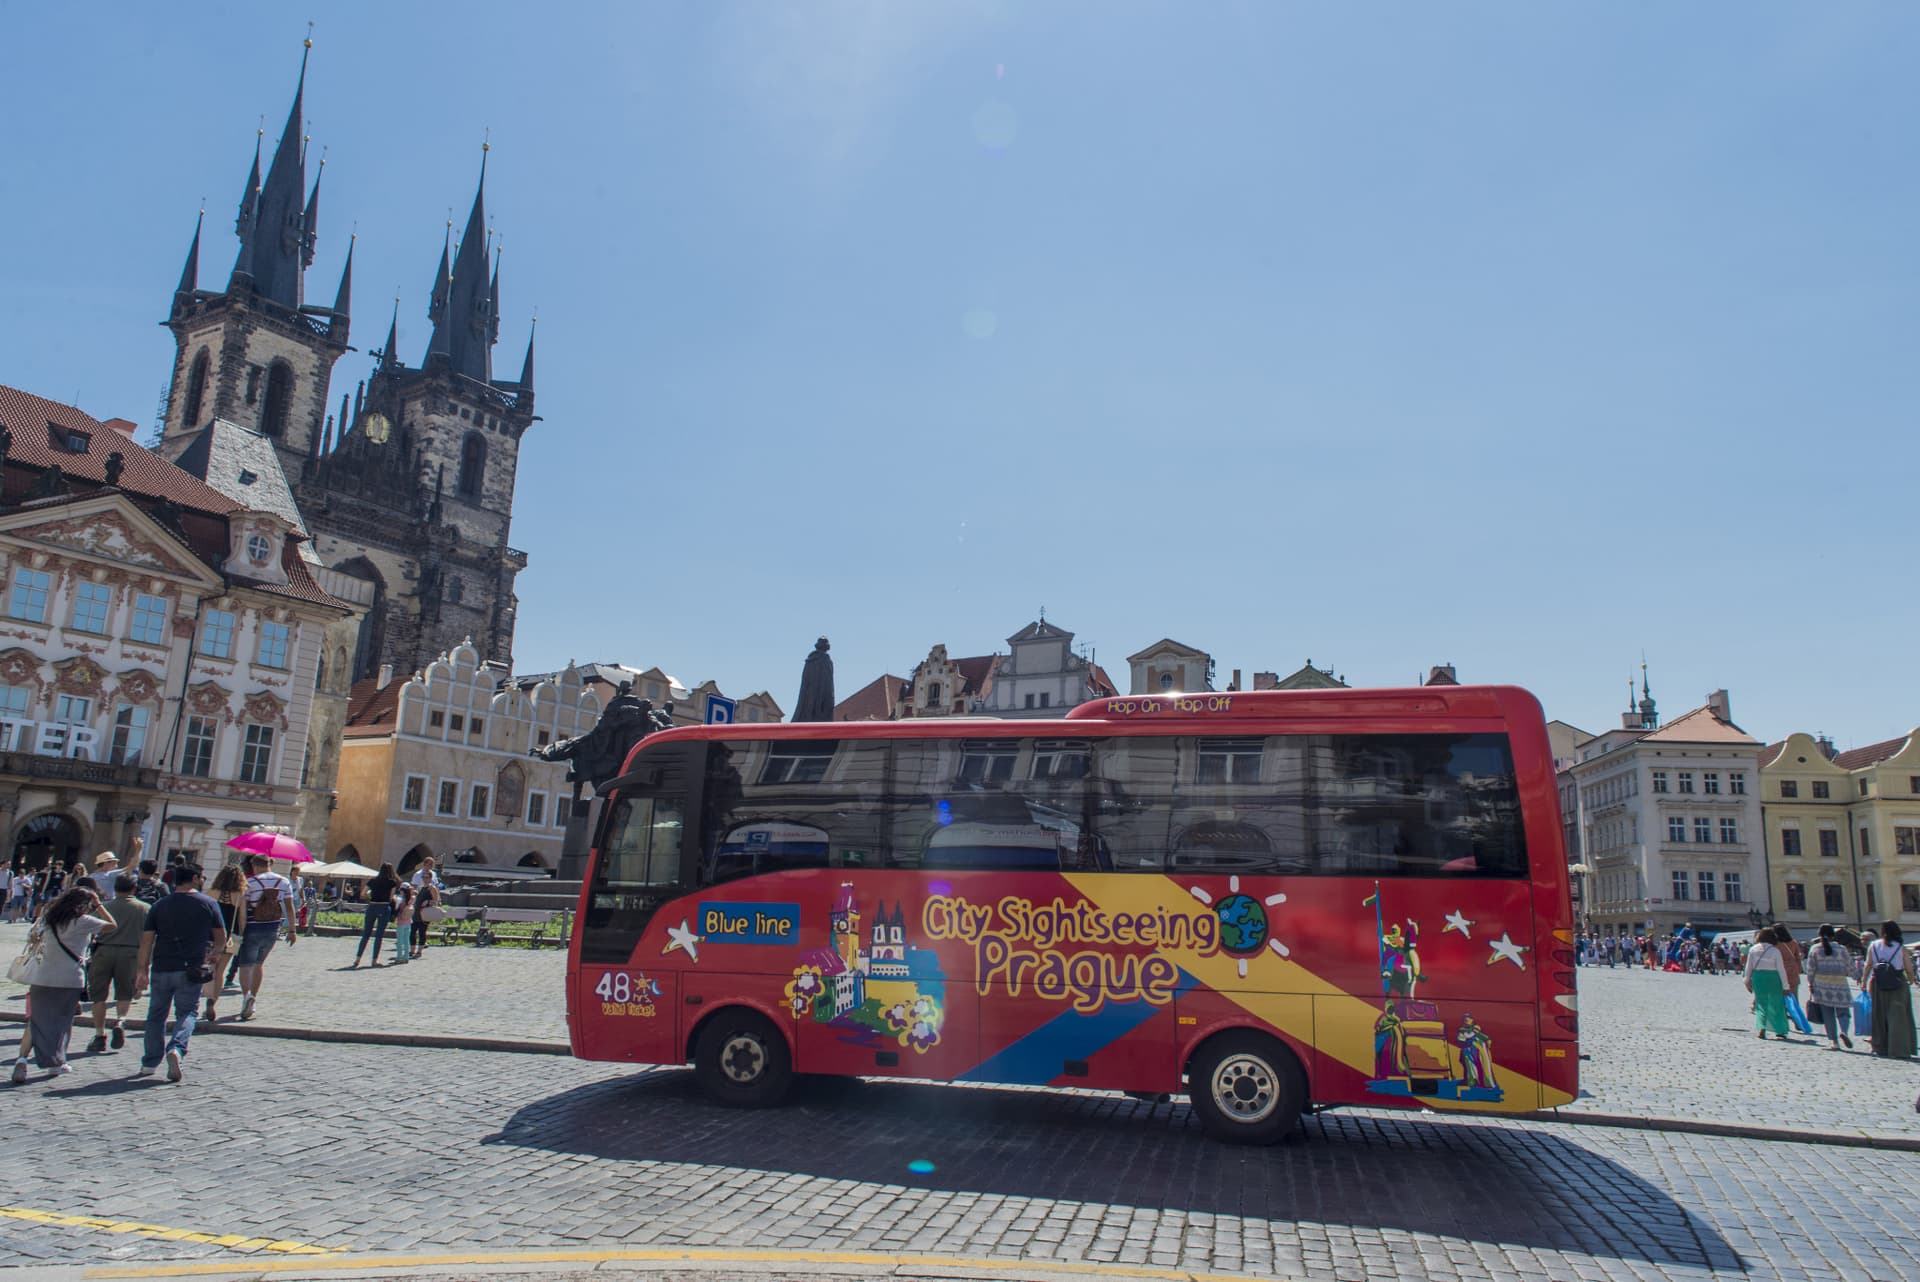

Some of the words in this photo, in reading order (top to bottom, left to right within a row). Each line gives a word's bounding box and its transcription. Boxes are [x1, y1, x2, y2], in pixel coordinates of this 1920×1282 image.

[1107, 701, 1137, 715] Hop
[1141, 699, 1161, 713] On
[1173, 698, 1204, 713] Hop
[1208, 696, 1232, 712] Off
[705, 910, 750, 936] Blue
[754, 911, 793, 937] line
[923, 895, 992, 942] City
[999, 896, 1220, 954] Sightseeing
[594, 971, 631, 1003] 48
[976, 931, 1176, 1012] Prague
